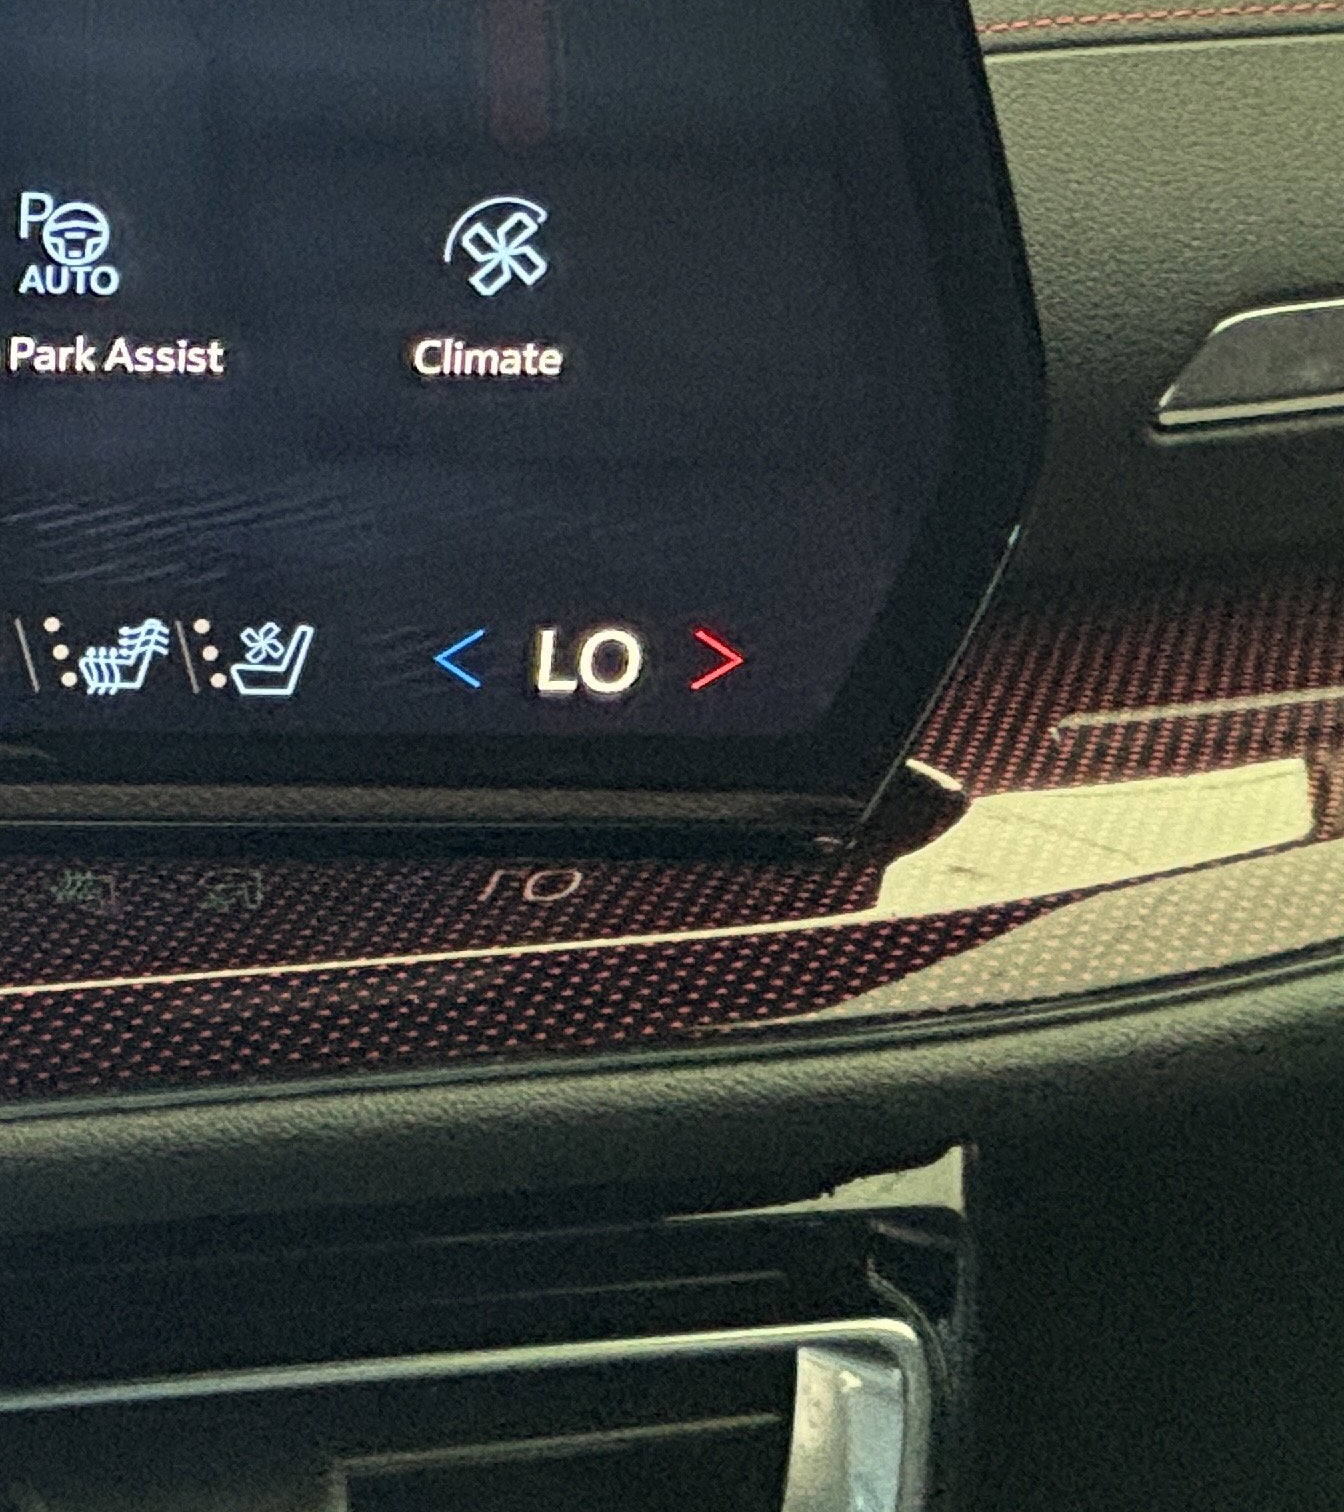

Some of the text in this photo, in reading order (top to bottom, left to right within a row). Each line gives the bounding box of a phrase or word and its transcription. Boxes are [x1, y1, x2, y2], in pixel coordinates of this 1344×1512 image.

[18, 190, 52, 240] P
[17, 263, 122, 297] AUTO
[8, 333, 98, 374] Park
[102, 335, 225, 375] Assist
[412, 336, 565, 377] Climate
[535, 627, 643, 695] LO
